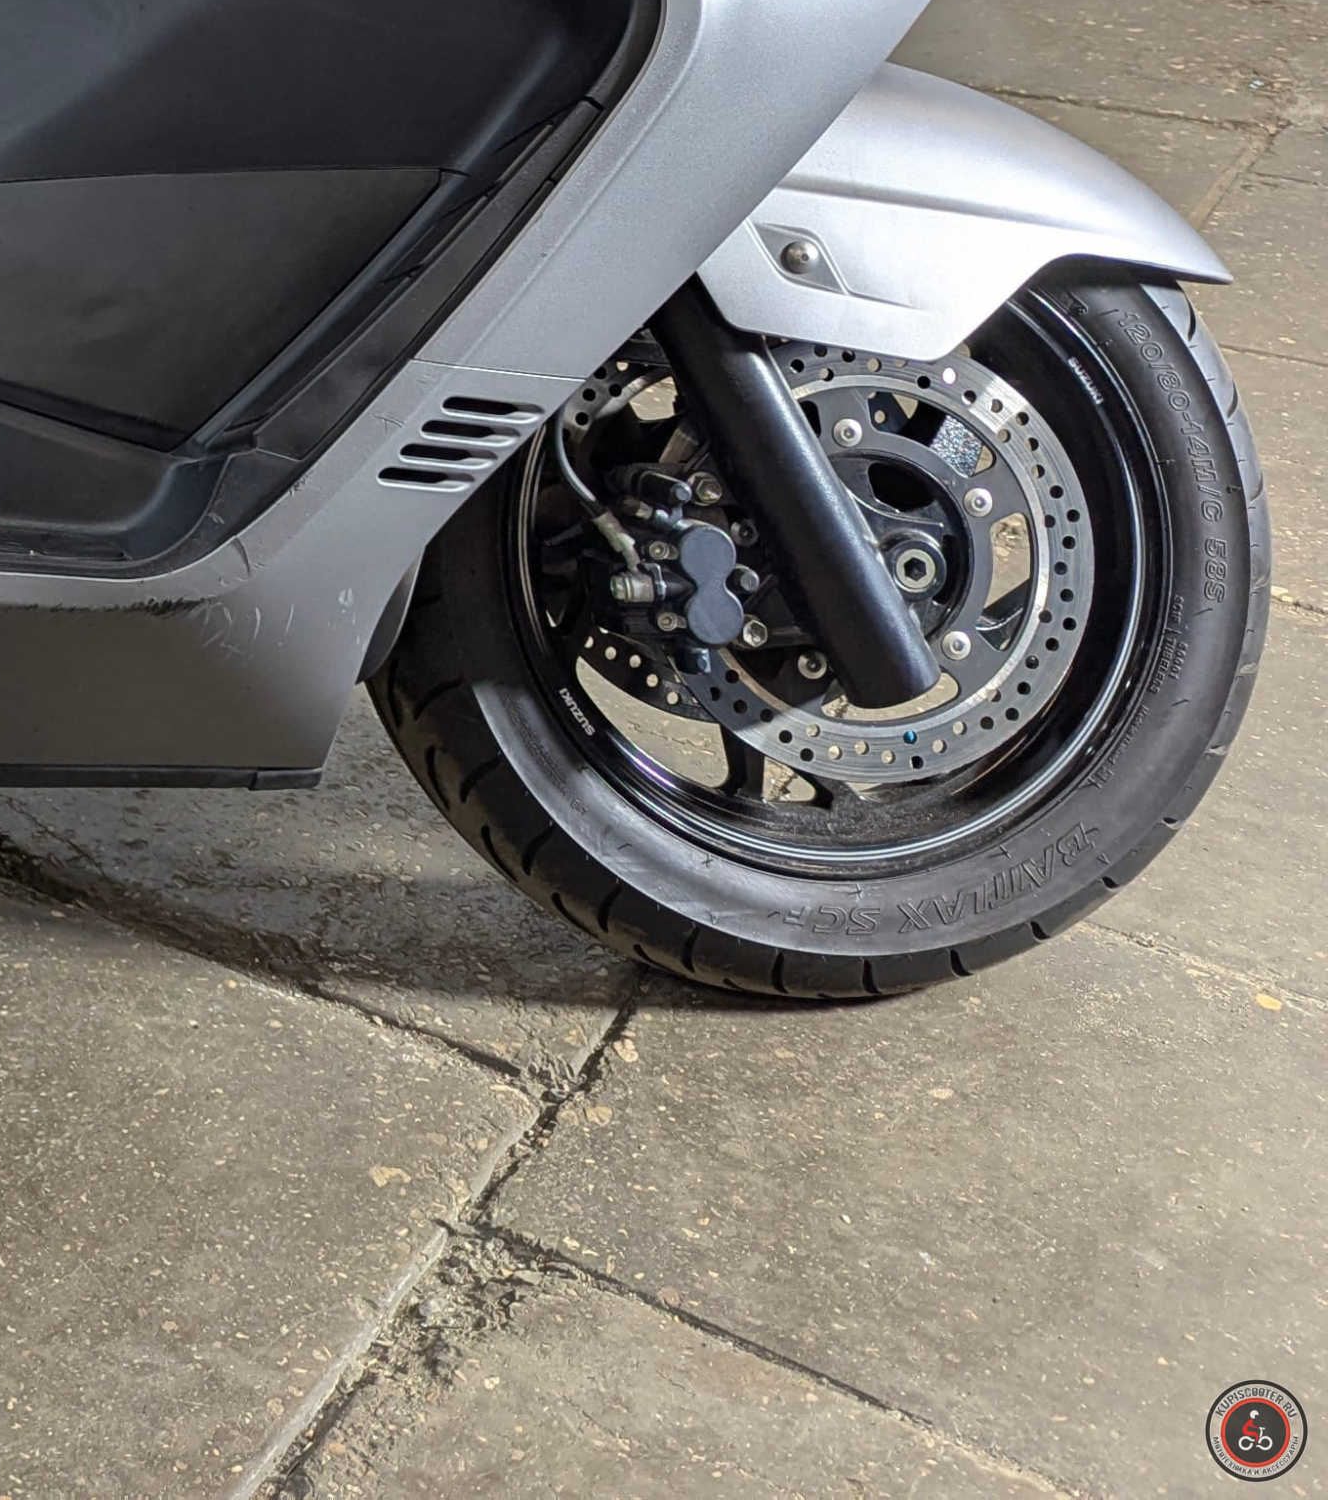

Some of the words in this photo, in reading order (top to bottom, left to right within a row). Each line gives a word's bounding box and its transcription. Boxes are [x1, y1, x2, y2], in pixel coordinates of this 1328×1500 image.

[1066, 355, 1104, 406] SUZUKI
[1203, 536, 1228, 604] 58S
[558, 687, 596, 736] SUZUKI
